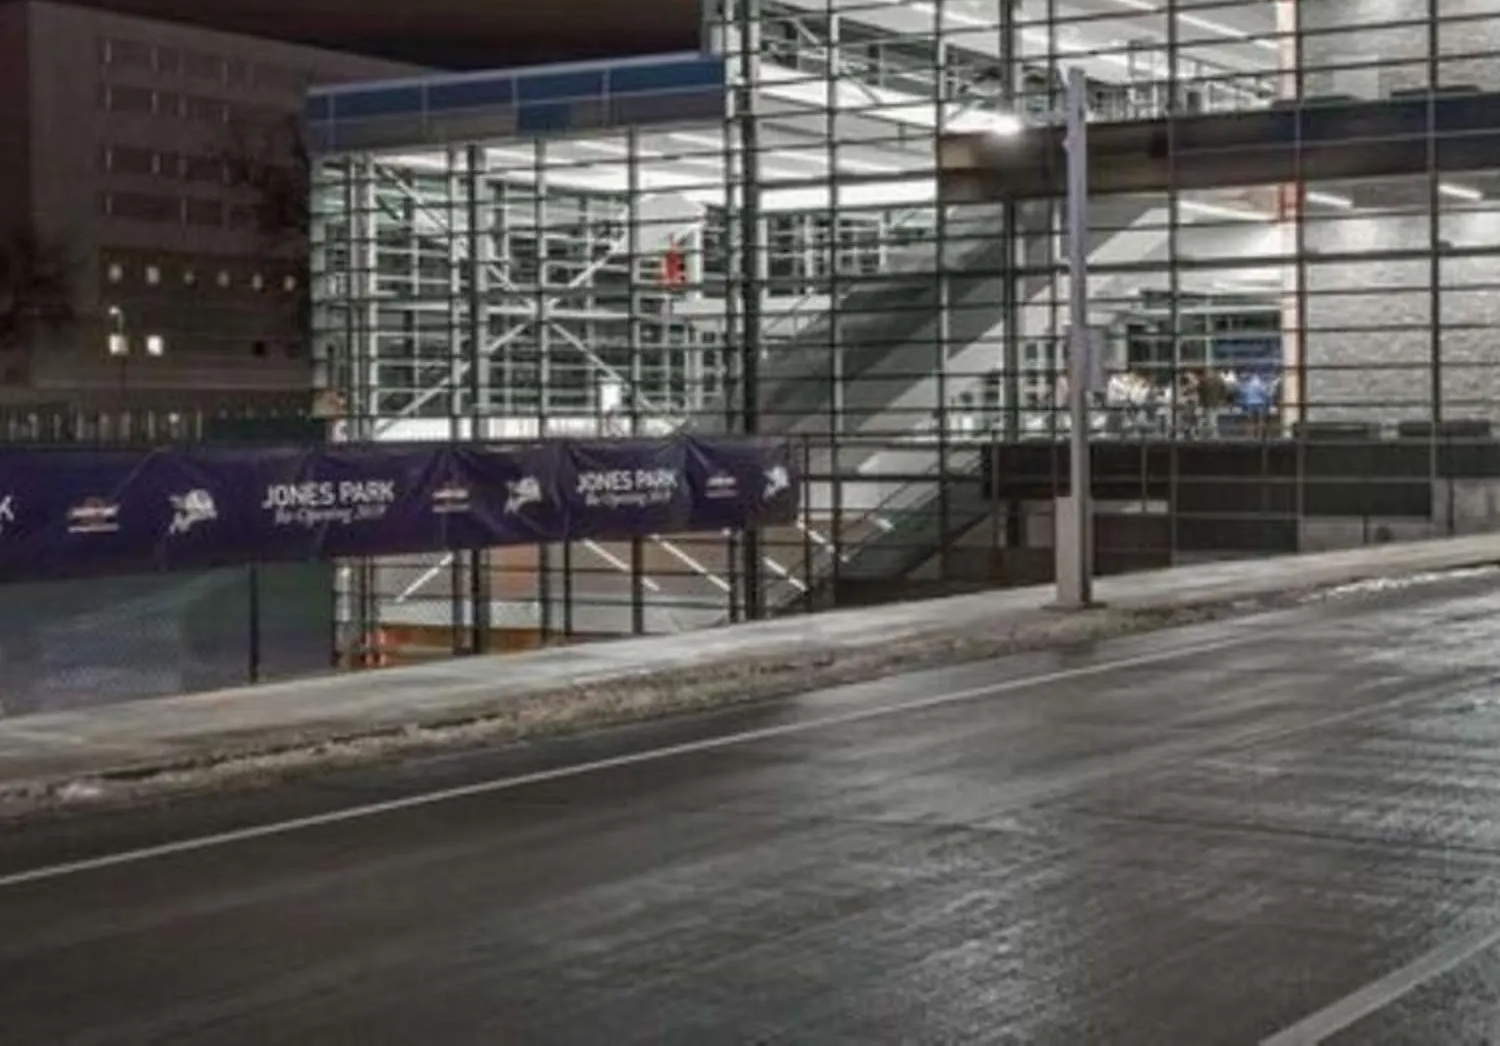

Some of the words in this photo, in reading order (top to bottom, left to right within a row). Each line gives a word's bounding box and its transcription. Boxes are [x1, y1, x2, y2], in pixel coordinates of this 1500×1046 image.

[262, 481, 335, 508] JONES
[339, 480, 395, 504] PARK
[576, 471, 632, 493] JONES
[636, 469, 677, 489] PARK
